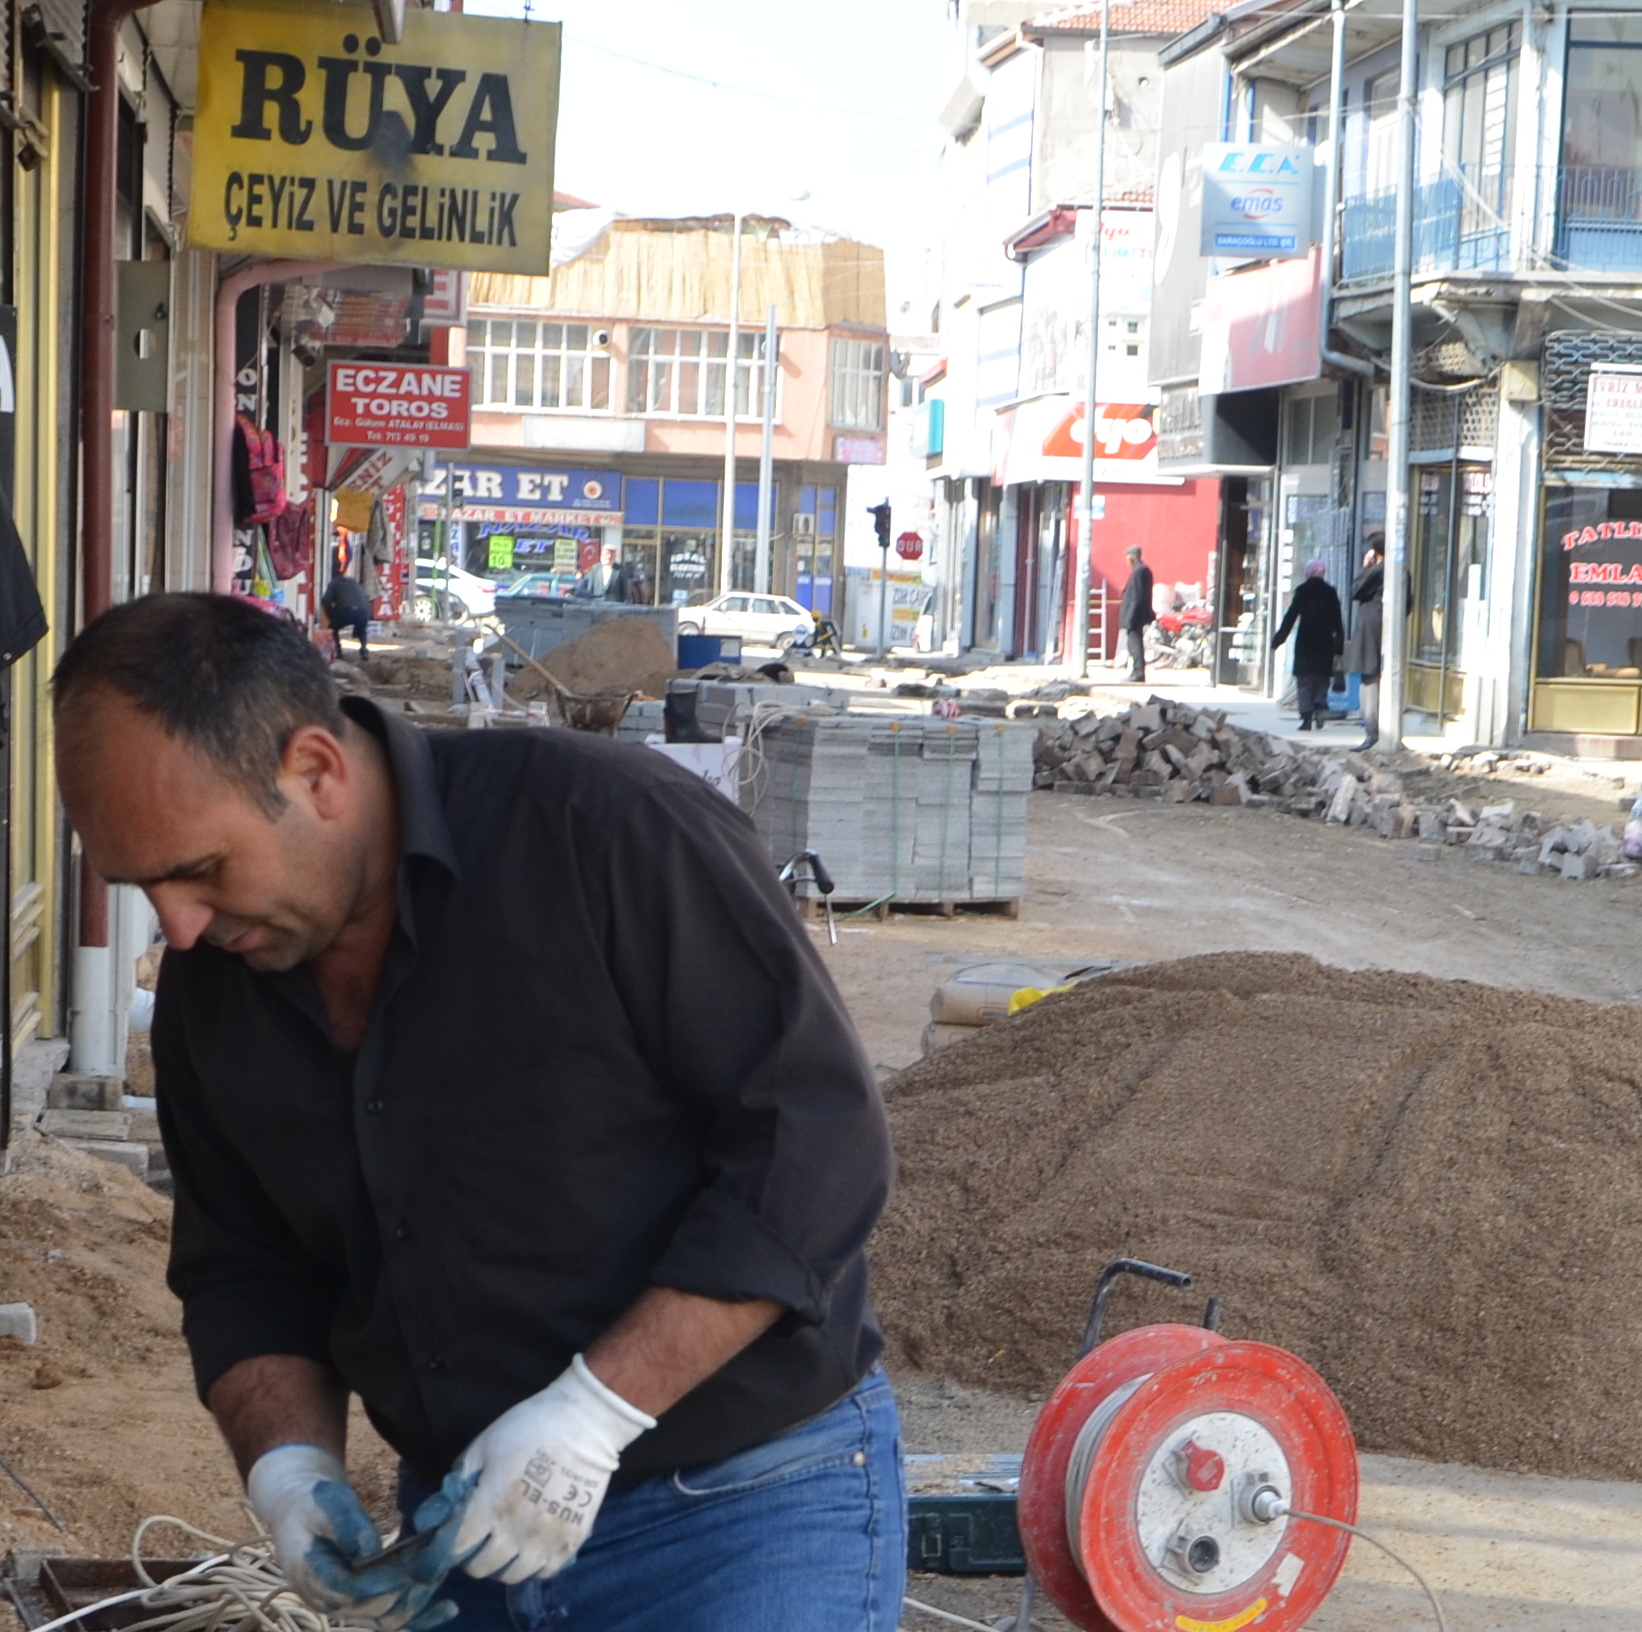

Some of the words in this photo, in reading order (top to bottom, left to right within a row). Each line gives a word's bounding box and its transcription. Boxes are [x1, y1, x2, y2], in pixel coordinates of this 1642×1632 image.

[231, 33, 527, 164] RÜYA
[327, 179, 367, 235] VE
[1230, 196, 1285, 212] emas
[336, 368, 462, 398] ECZANE
[351, 397, 449, 419] TOROS
[1070, 405, 1153, 454] dyo
[517, 471, 570, 501] ET
[513, 538, 554, 553] ET
[898, 539, 922, 552] DUR
[1569, 590, 1579, 605] 0
